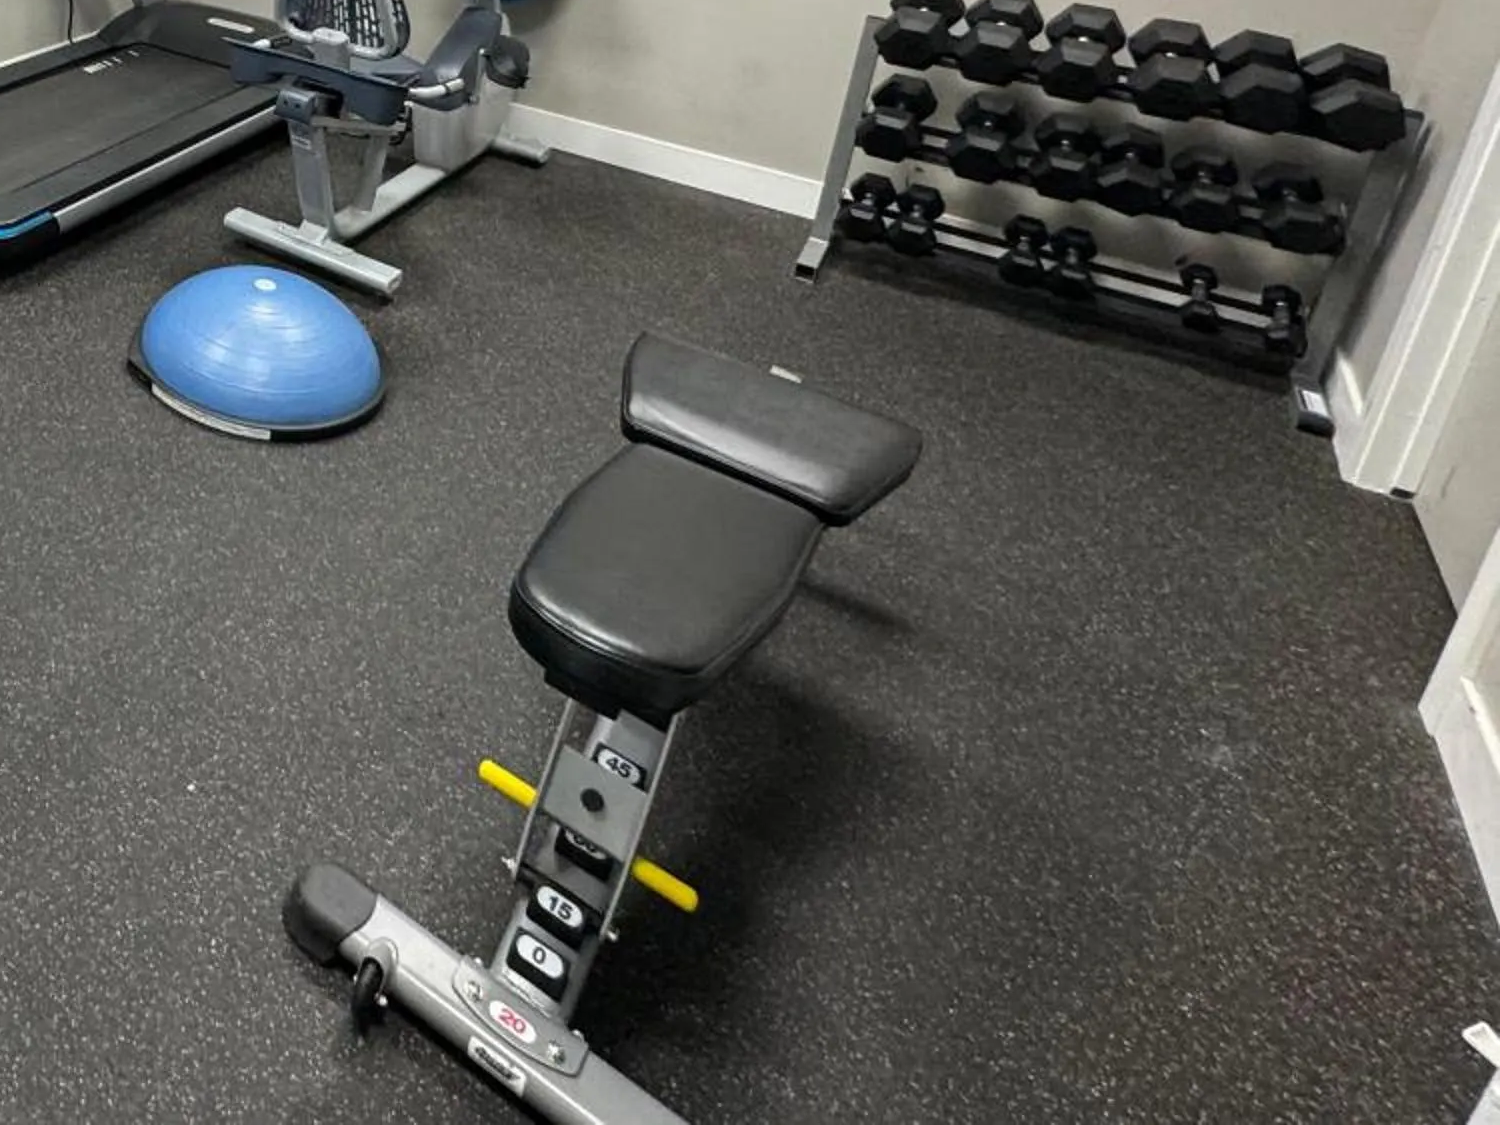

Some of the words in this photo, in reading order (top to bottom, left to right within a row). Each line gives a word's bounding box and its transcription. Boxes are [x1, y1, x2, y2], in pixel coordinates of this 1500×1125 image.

[605, 757, 632, 779] 45
[549, 896, 573, 920] 15
[532, 946, 546, 965] 0
[499, 1008, 526, 1034] 20
